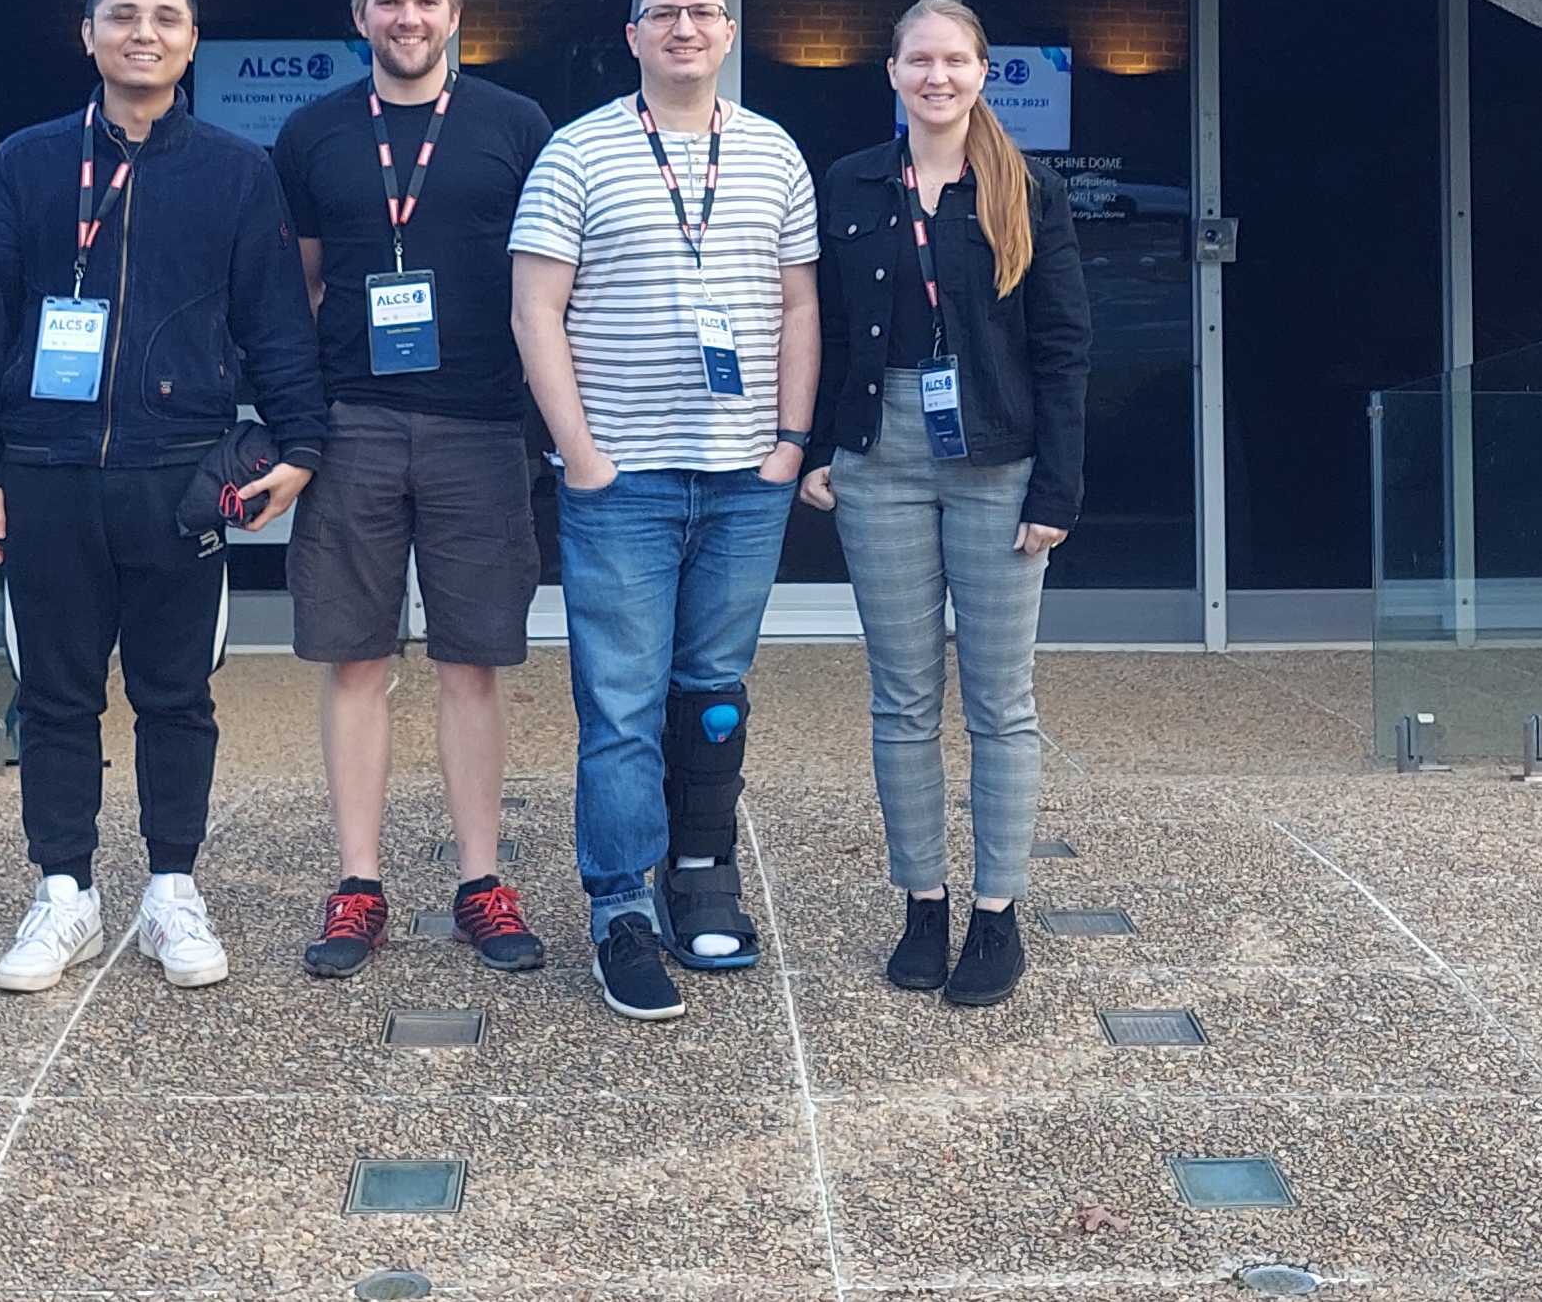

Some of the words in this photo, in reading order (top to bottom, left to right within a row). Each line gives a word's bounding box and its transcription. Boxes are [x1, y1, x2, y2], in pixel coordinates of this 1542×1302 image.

[238, 57, 303, 78] ALCS
[1007, 61, 1029, 83] 23
[221, 93, 274, 104] WELCOME
[279, 93, 293, 104] TO
[1054, 156, 1087, 169] SHINE
[1088, 156, 1123, 169] DOME
[376, 292, 410, 306] ALCS
[49, 319, 83, 330] ALCS
[925, 379, 944, 392] ALCS
